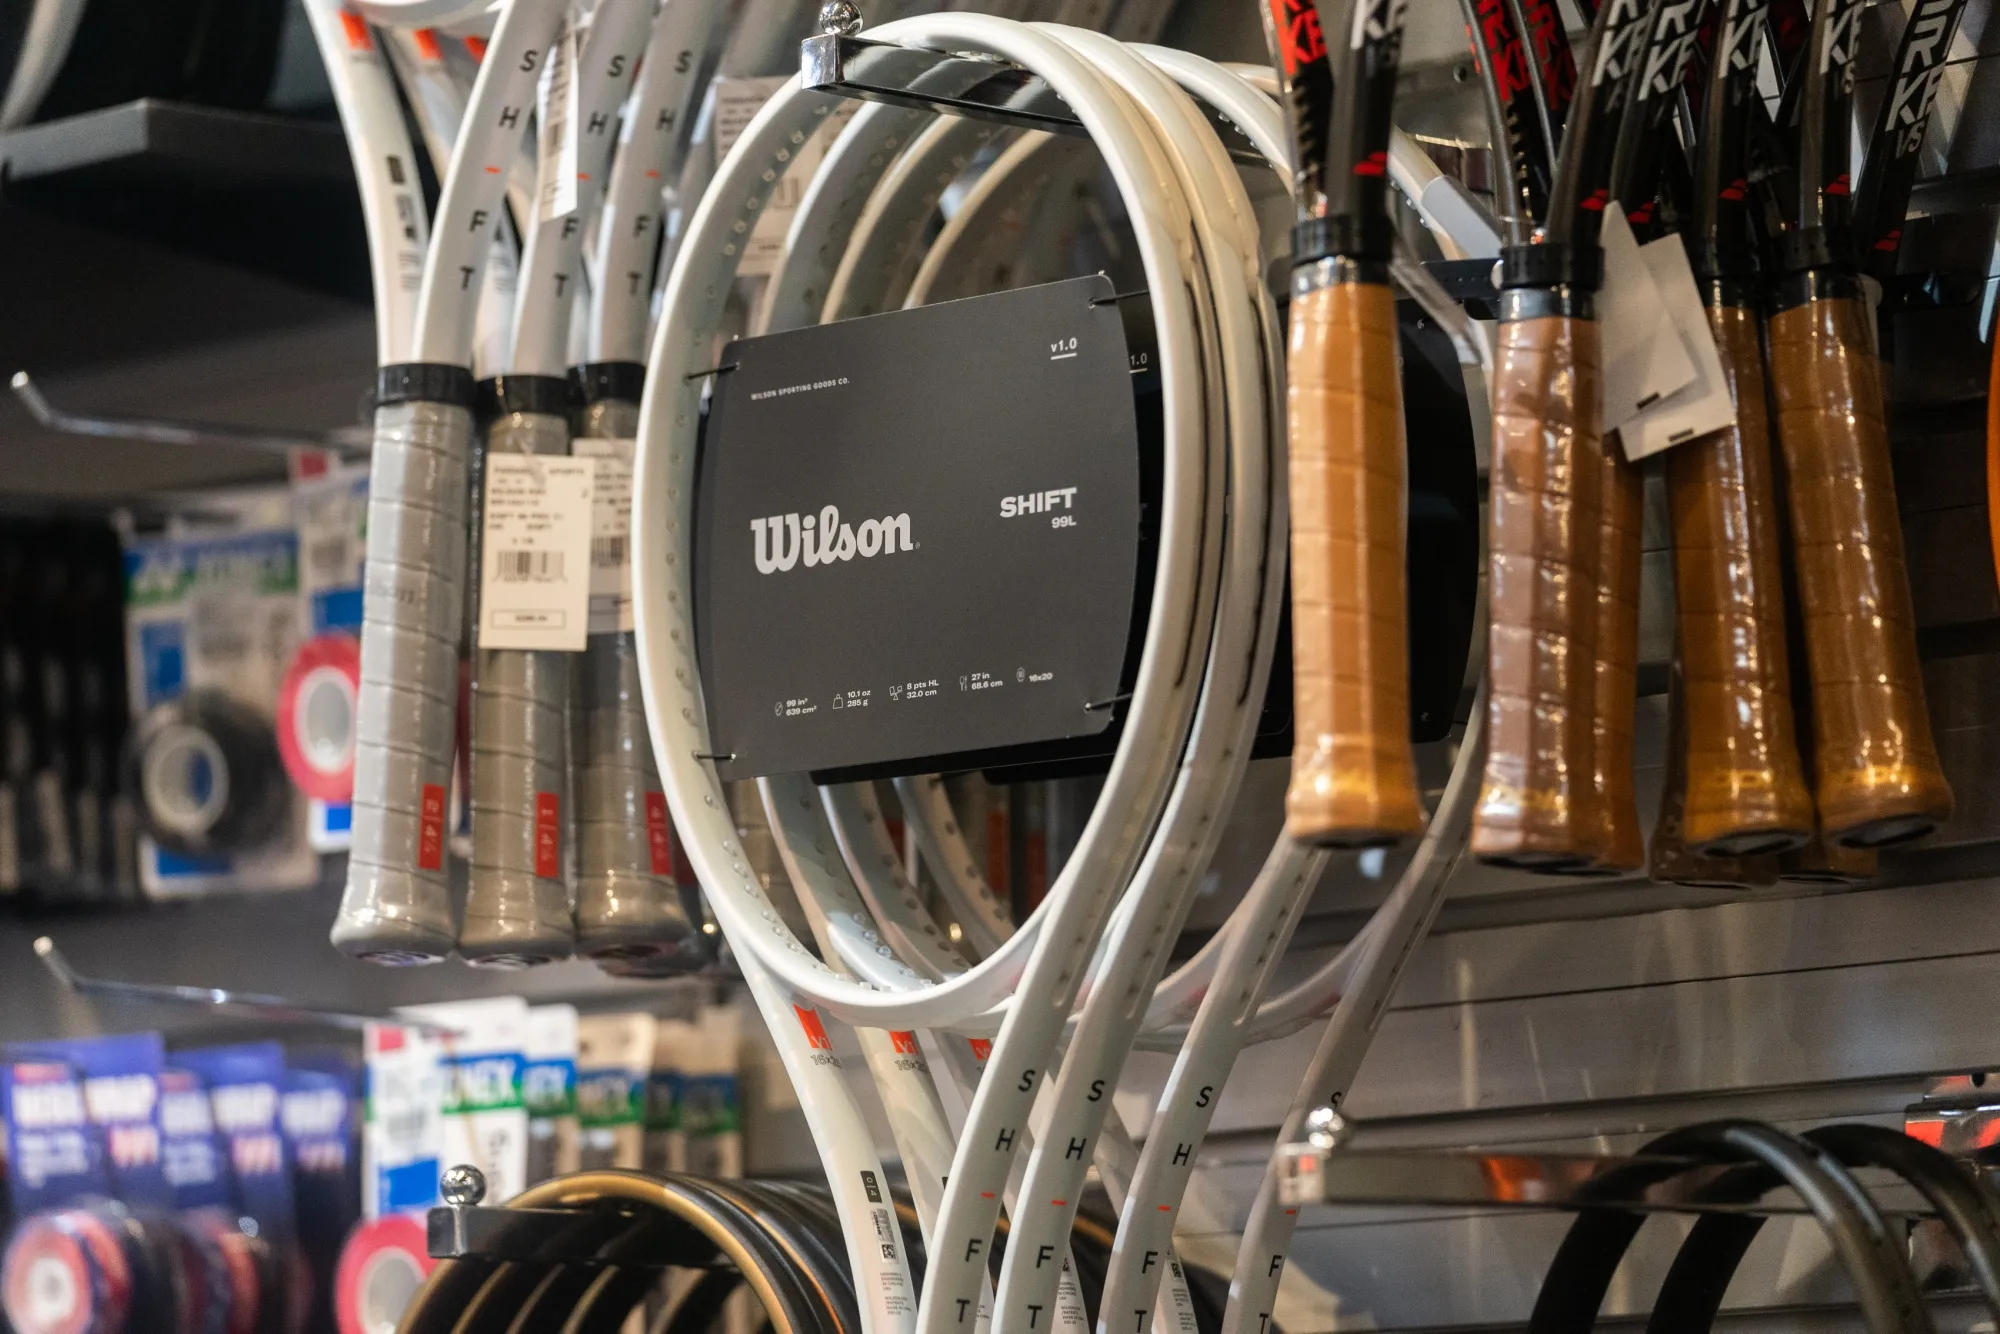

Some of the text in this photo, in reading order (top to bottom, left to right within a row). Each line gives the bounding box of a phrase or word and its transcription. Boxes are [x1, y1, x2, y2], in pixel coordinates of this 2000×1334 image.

[1051, 337, 1077, 353] v1.0
[778, 384, 812, 396] SPORTING
[813, 379, 836, 390] GOODS
[838, 377, 850, 385] CO.
[1000, 487, 1077, 518] SHIFT
[1052, 515, 1077, 529] 99L
[750, 505, 914, 574] Wilson
[971, 673, 981, 681] 27
[913, 681, 926, 690] pts
[971, 681, 989, 690] 68.6
[847, 690, 860, 698] 10.1
[906, 689, 937, 699] 32.0 cm
[786, 699, 796, 708] 99
[847, 699, 861, 708] 285
[786, 708, 801, 716] 639
